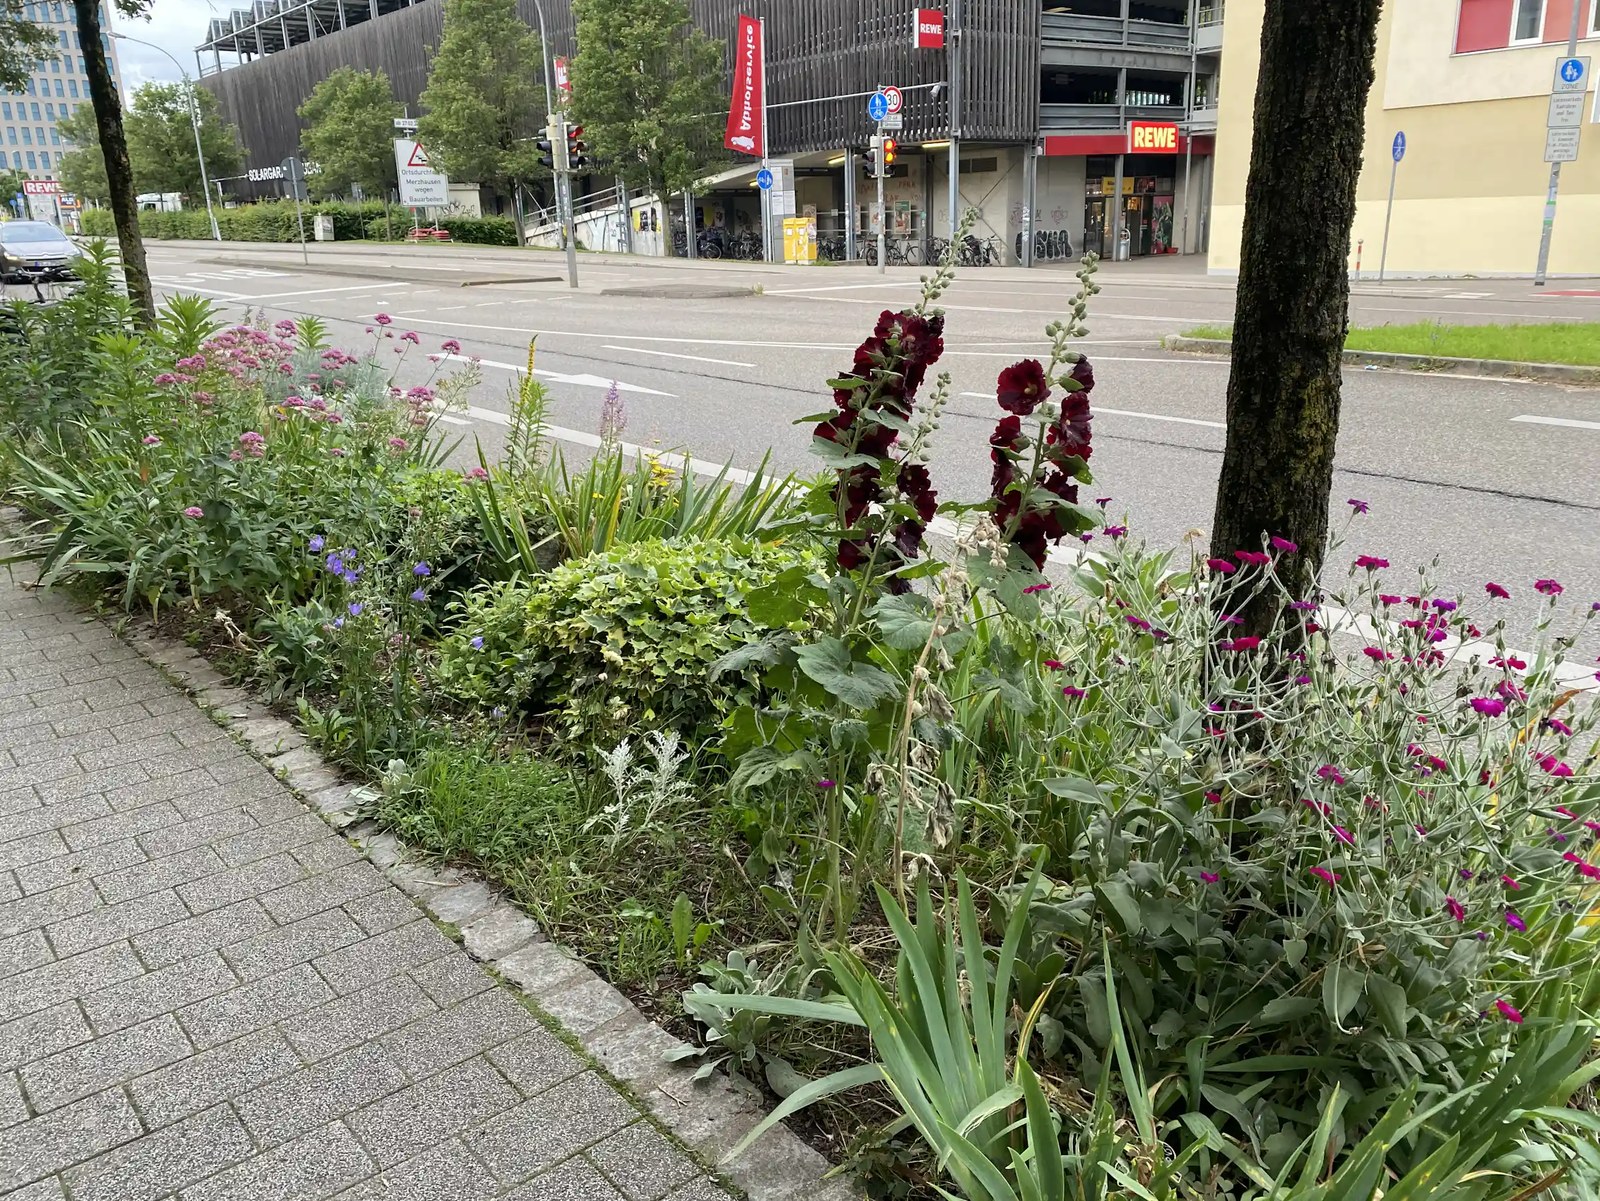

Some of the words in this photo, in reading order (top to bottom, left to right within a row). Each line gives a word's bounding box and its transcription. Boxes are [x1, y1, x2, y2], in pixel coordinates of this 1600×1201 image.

[920, 23, 942, 35] REWE
[886, 93, 898, 106] 30
[1134, 126, 1176, 148] REWE
